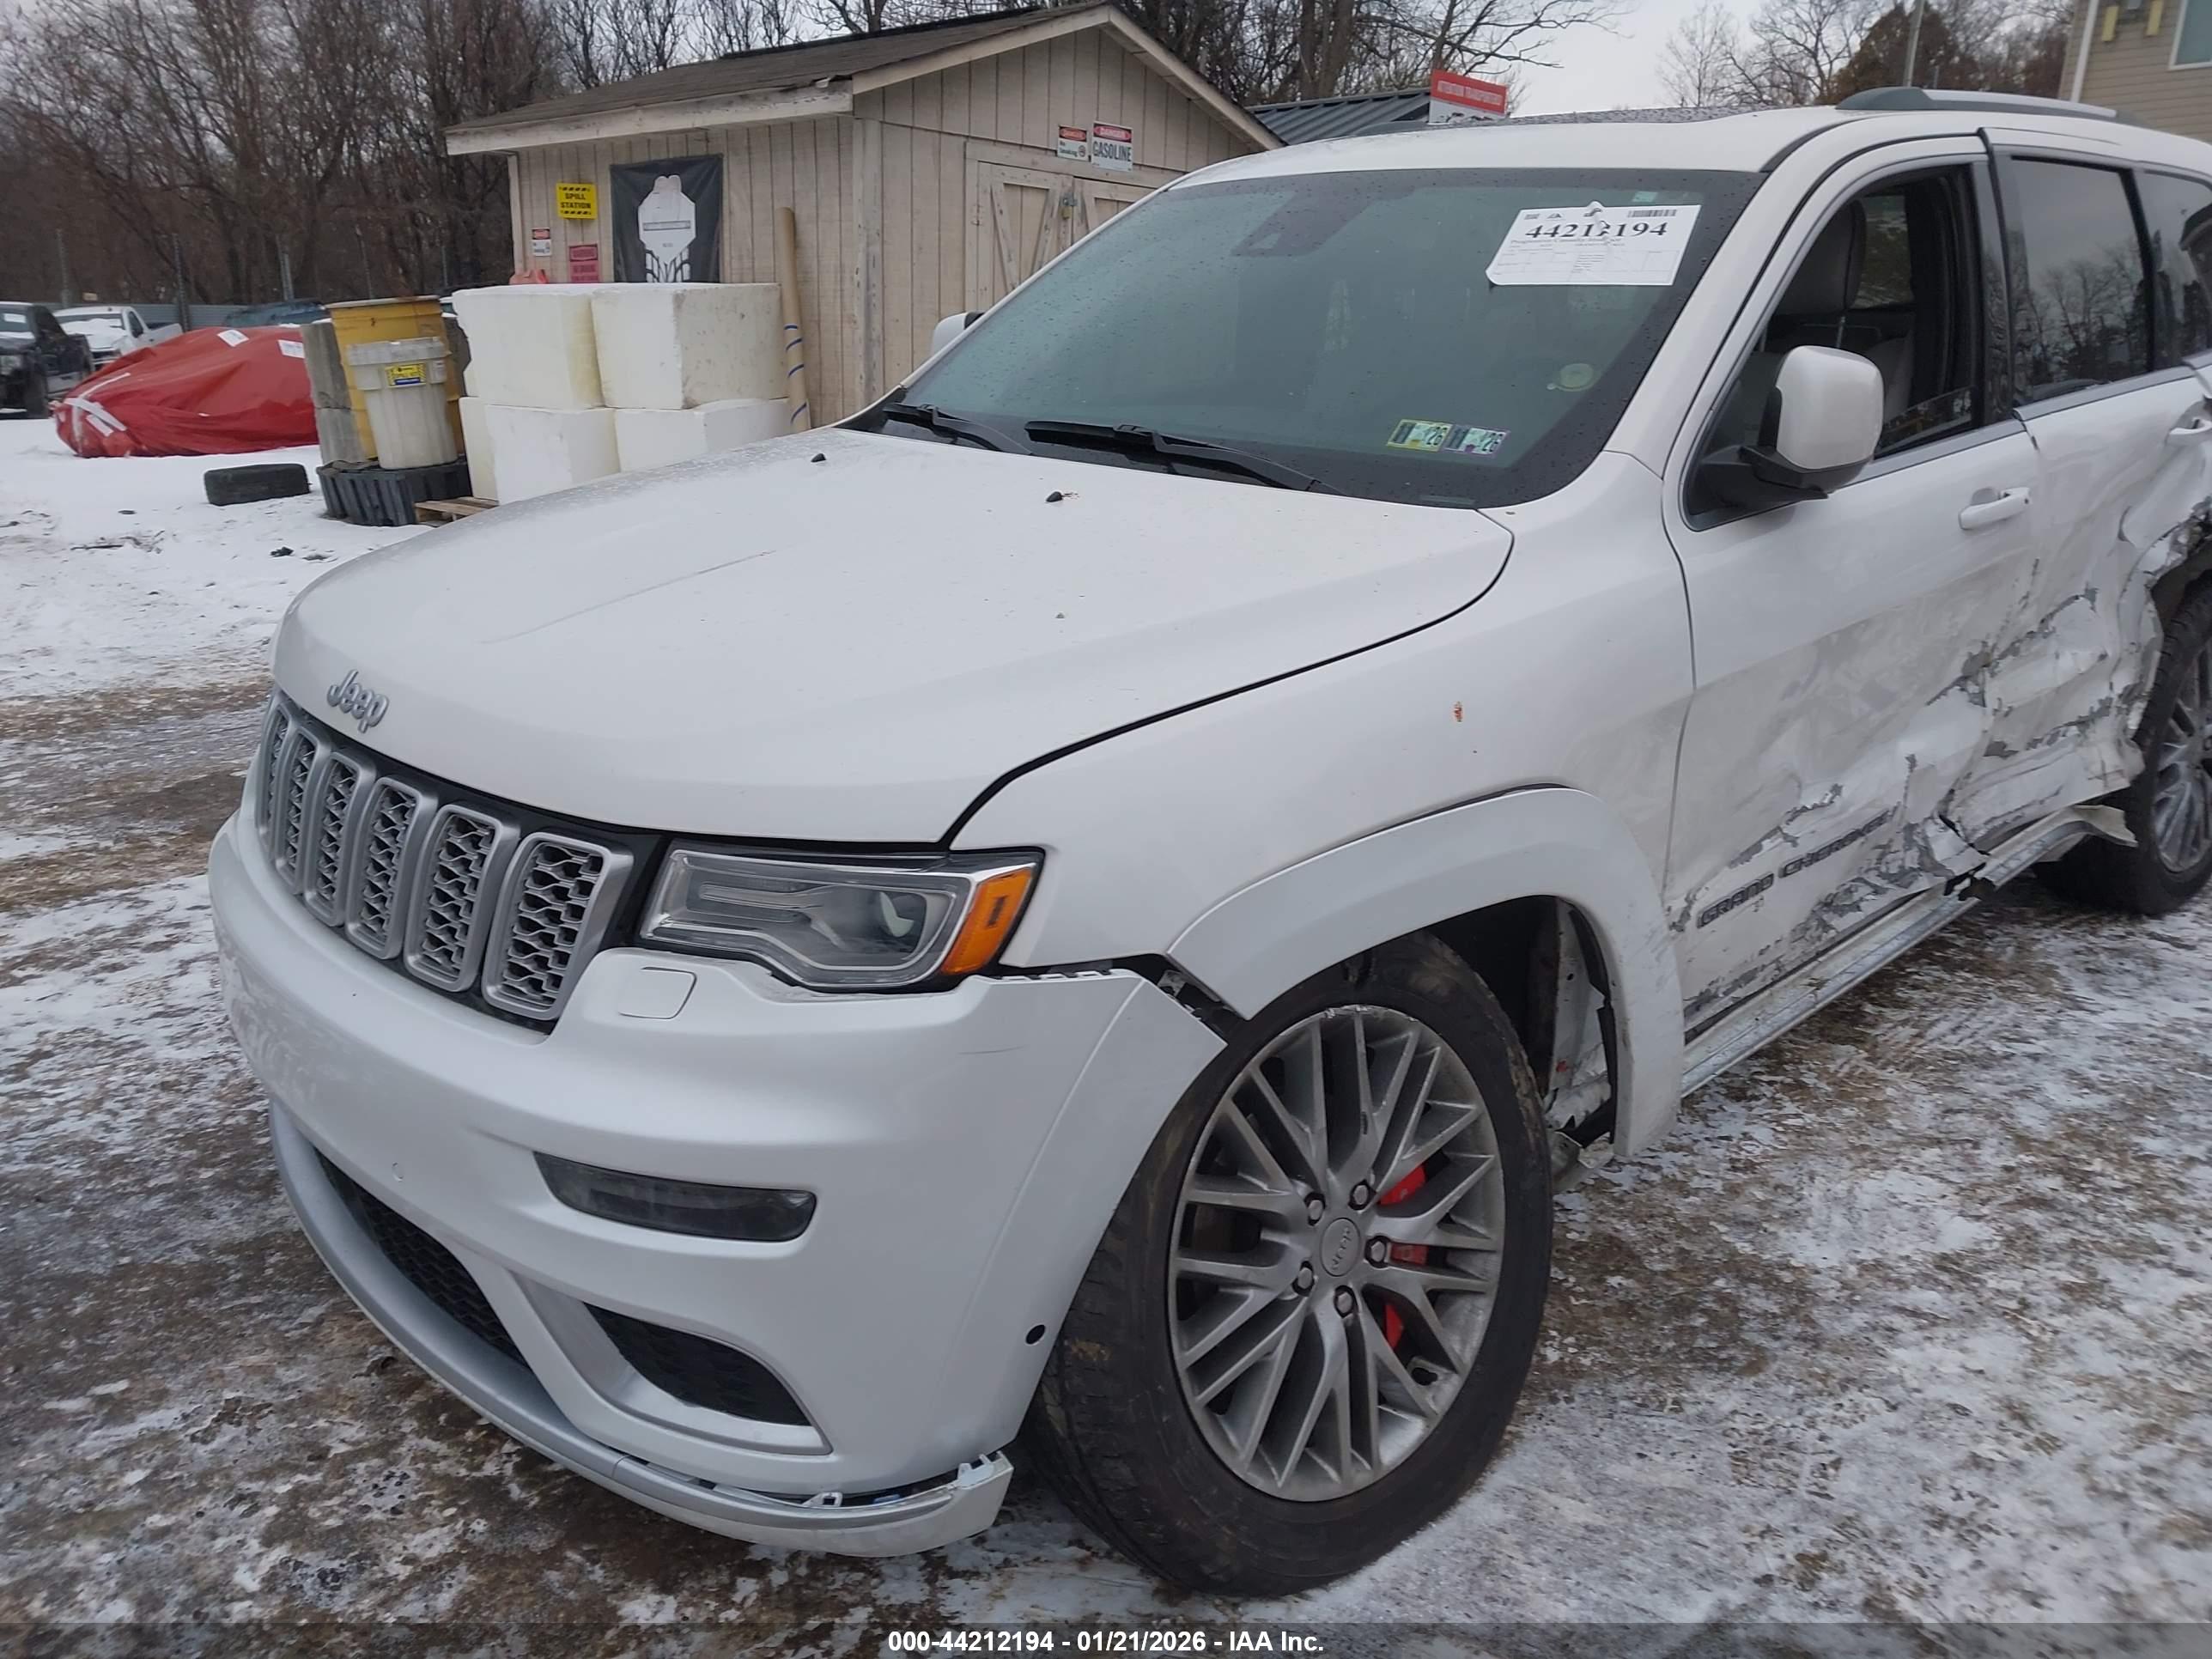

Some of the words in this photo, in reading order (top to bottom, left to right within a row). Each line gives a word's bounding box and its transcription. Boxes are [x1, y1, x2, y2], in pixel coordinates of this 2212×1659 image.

[1092, 141, 1132, 161] GASOLINE
[327, 669, 389, 733] Jeep
[1697, 872, 1774, 928] GRAND
